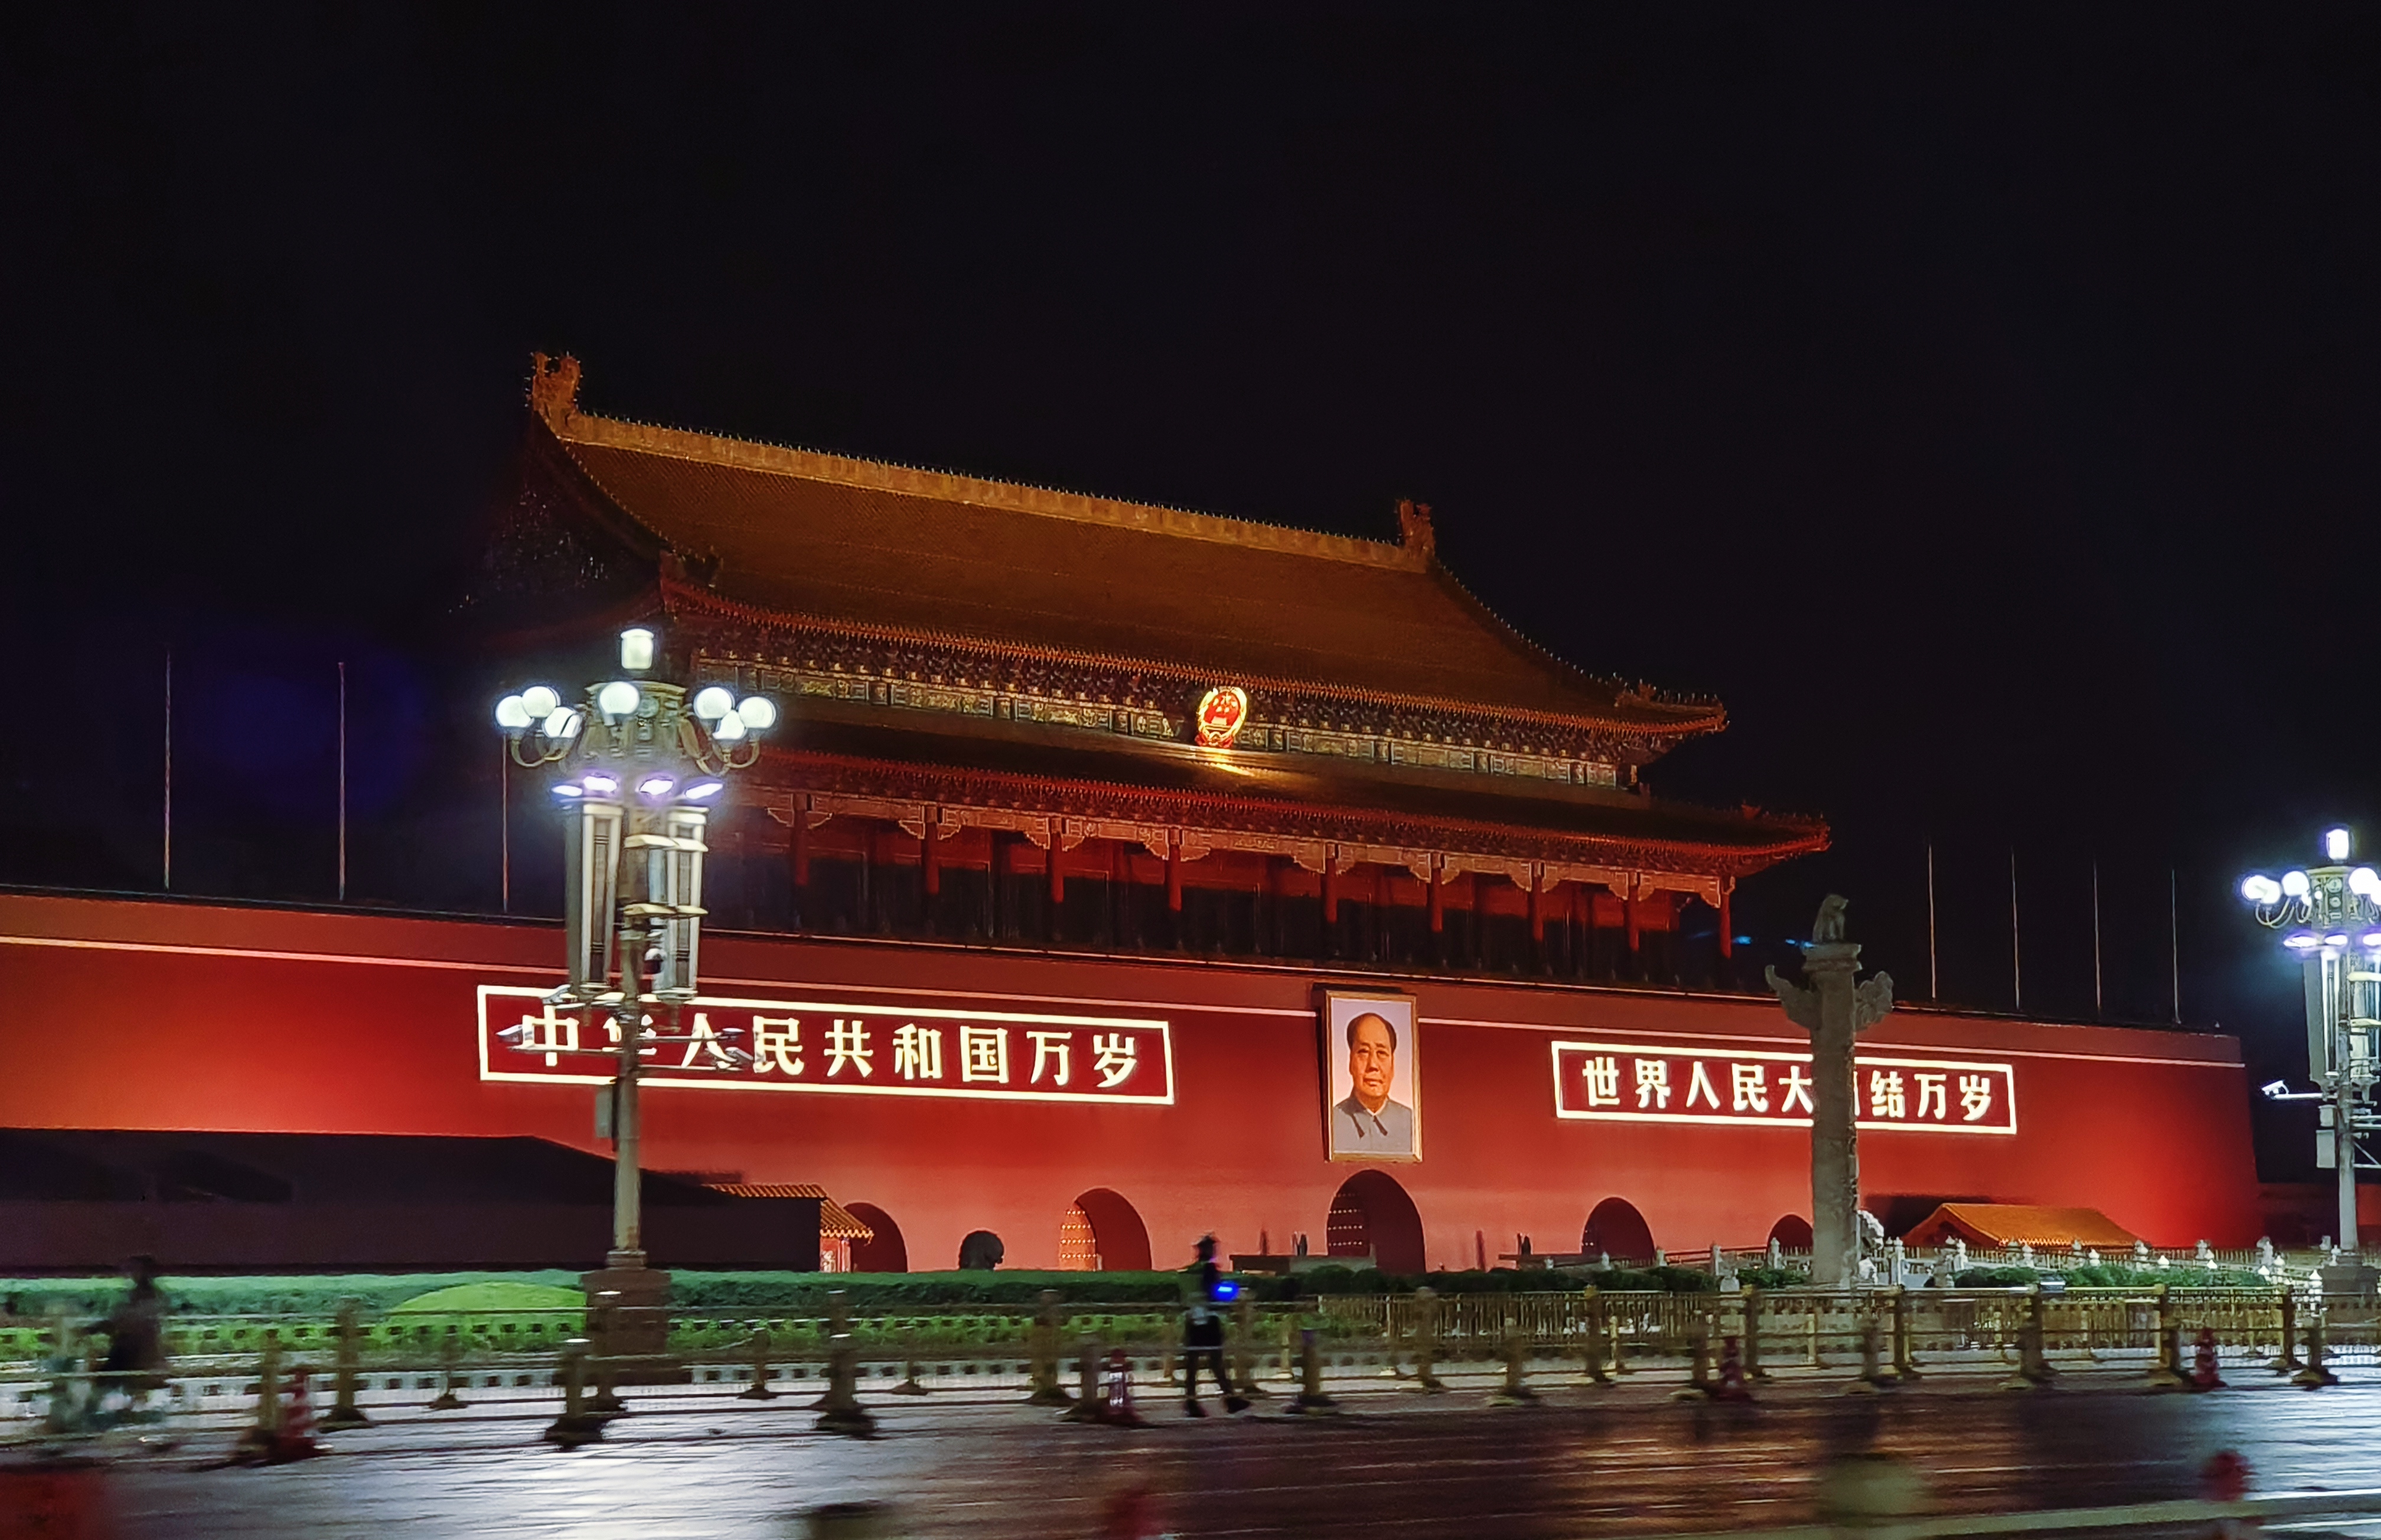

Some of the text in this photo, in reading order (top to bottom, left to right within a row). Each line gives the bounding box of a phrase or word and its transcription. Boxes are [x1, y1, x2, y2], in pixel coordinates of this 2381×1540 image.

[1582, 1056, 1991, 1121] 世界人民大结万岁
